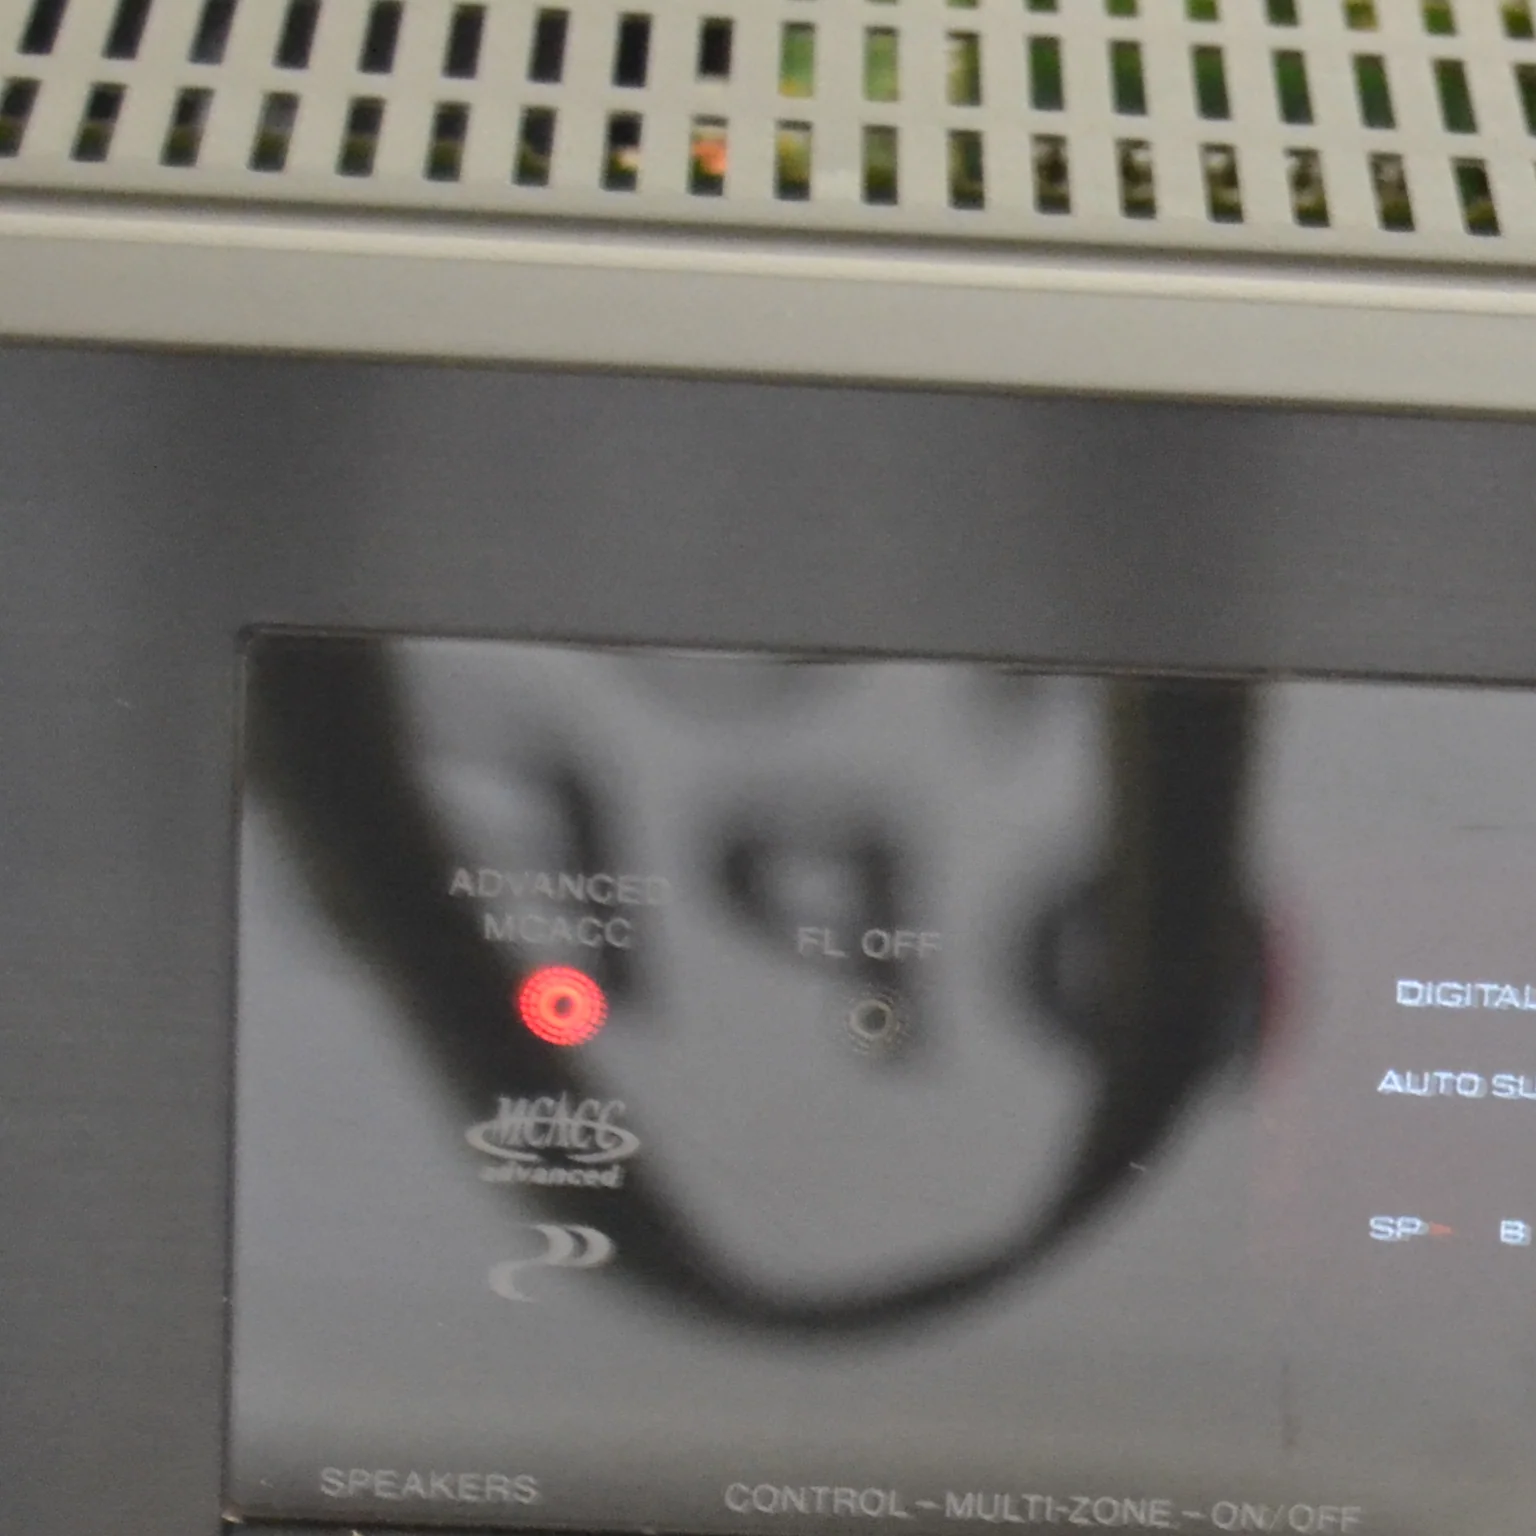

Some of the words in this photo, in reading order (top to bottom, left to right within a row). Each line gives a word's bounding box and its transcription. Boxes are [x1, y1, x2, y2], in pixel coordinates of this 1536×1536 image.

[449, 867, 670, 903] ADVANCED
[483, 912, 634, 949] MCACC
[797, 927, 844, 957] FL
[862, 929, 941, 959] OFF
[1378, 1069, 1486, 1097] AUTO
[1369, 1216, 1429, 1241] SP
[1500, 1219, 1531, 1246] B
[320, 1466, 541, 1503] SPEAKERS
[724, 1482, 911, 1519] CONTROL
[945, 1492, 1181, 1529] MULTI-ZONE
[1210, 1501, 1363, 1533] ON/OFF
